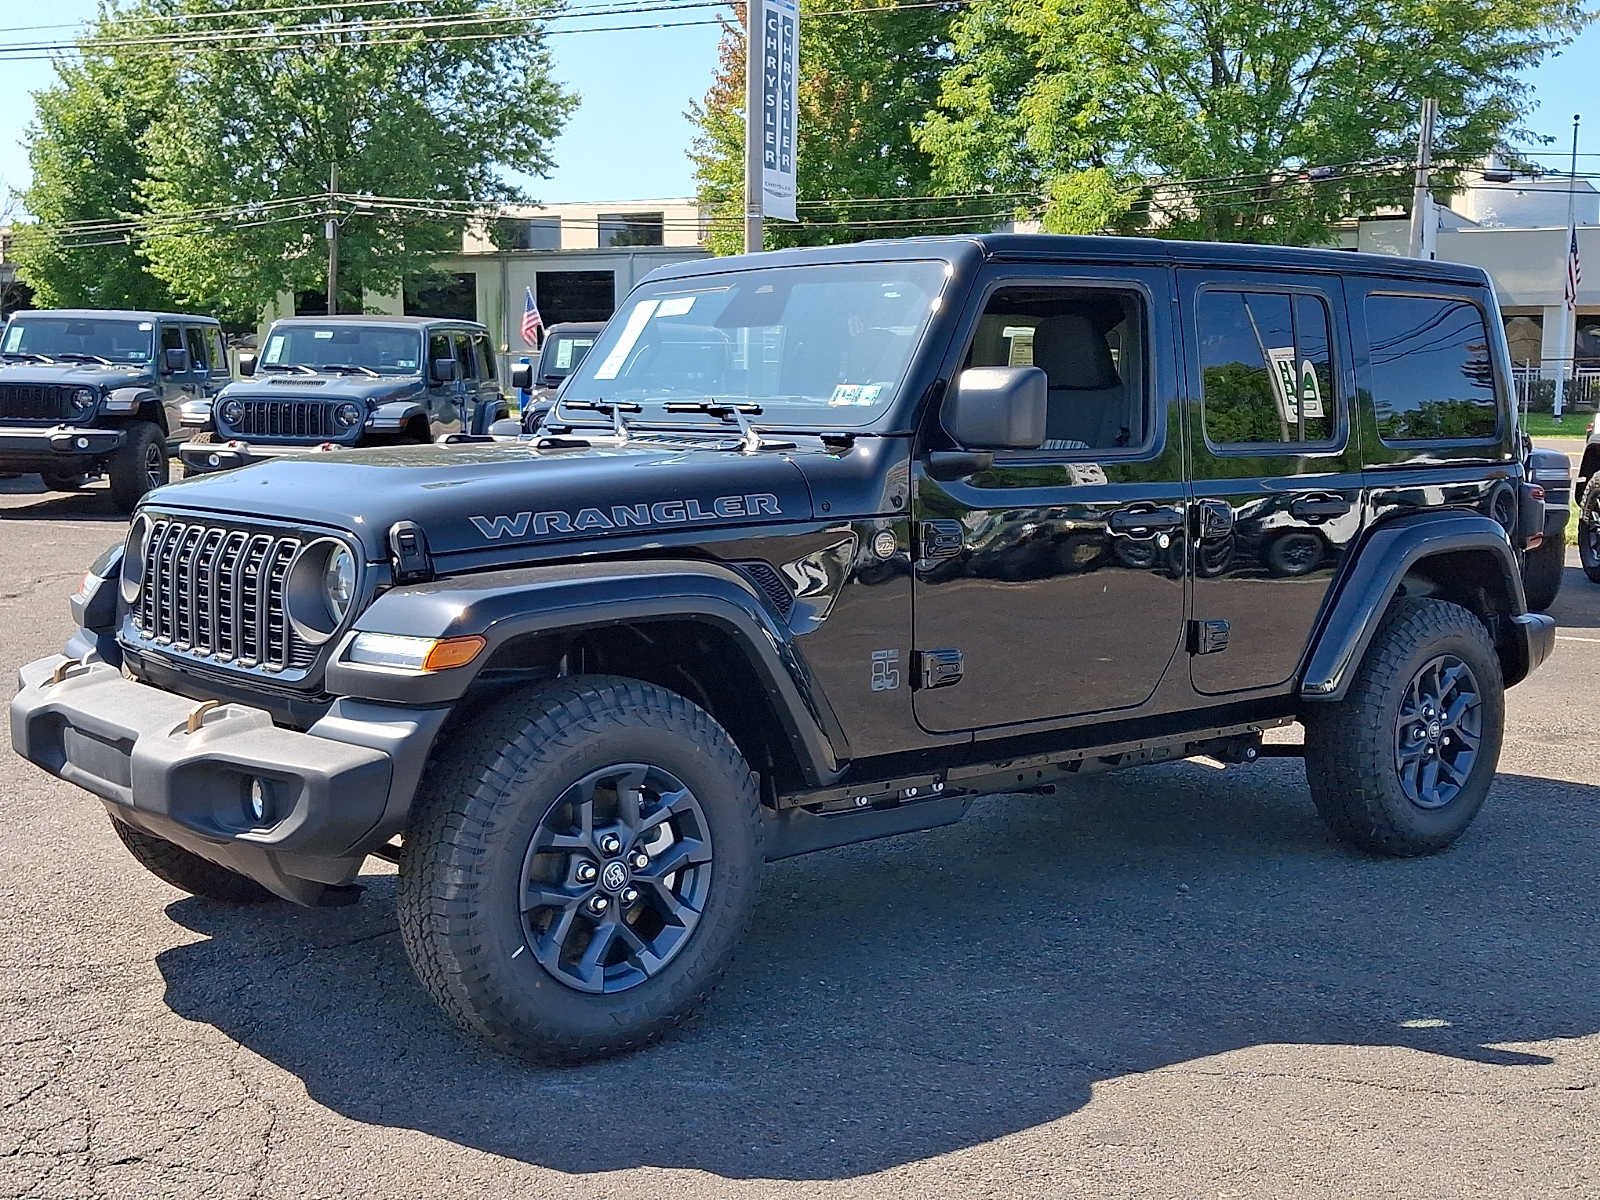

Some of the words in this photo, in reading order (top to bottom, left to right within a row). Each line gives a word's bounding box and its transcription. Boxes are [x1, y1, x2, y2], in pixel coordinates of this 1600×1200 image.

[766, 18, 778, 164] CHRYSLER
[782, 24, 793, 167] CHRYSLER
[468, 493, 783, 540] WRANGLER
